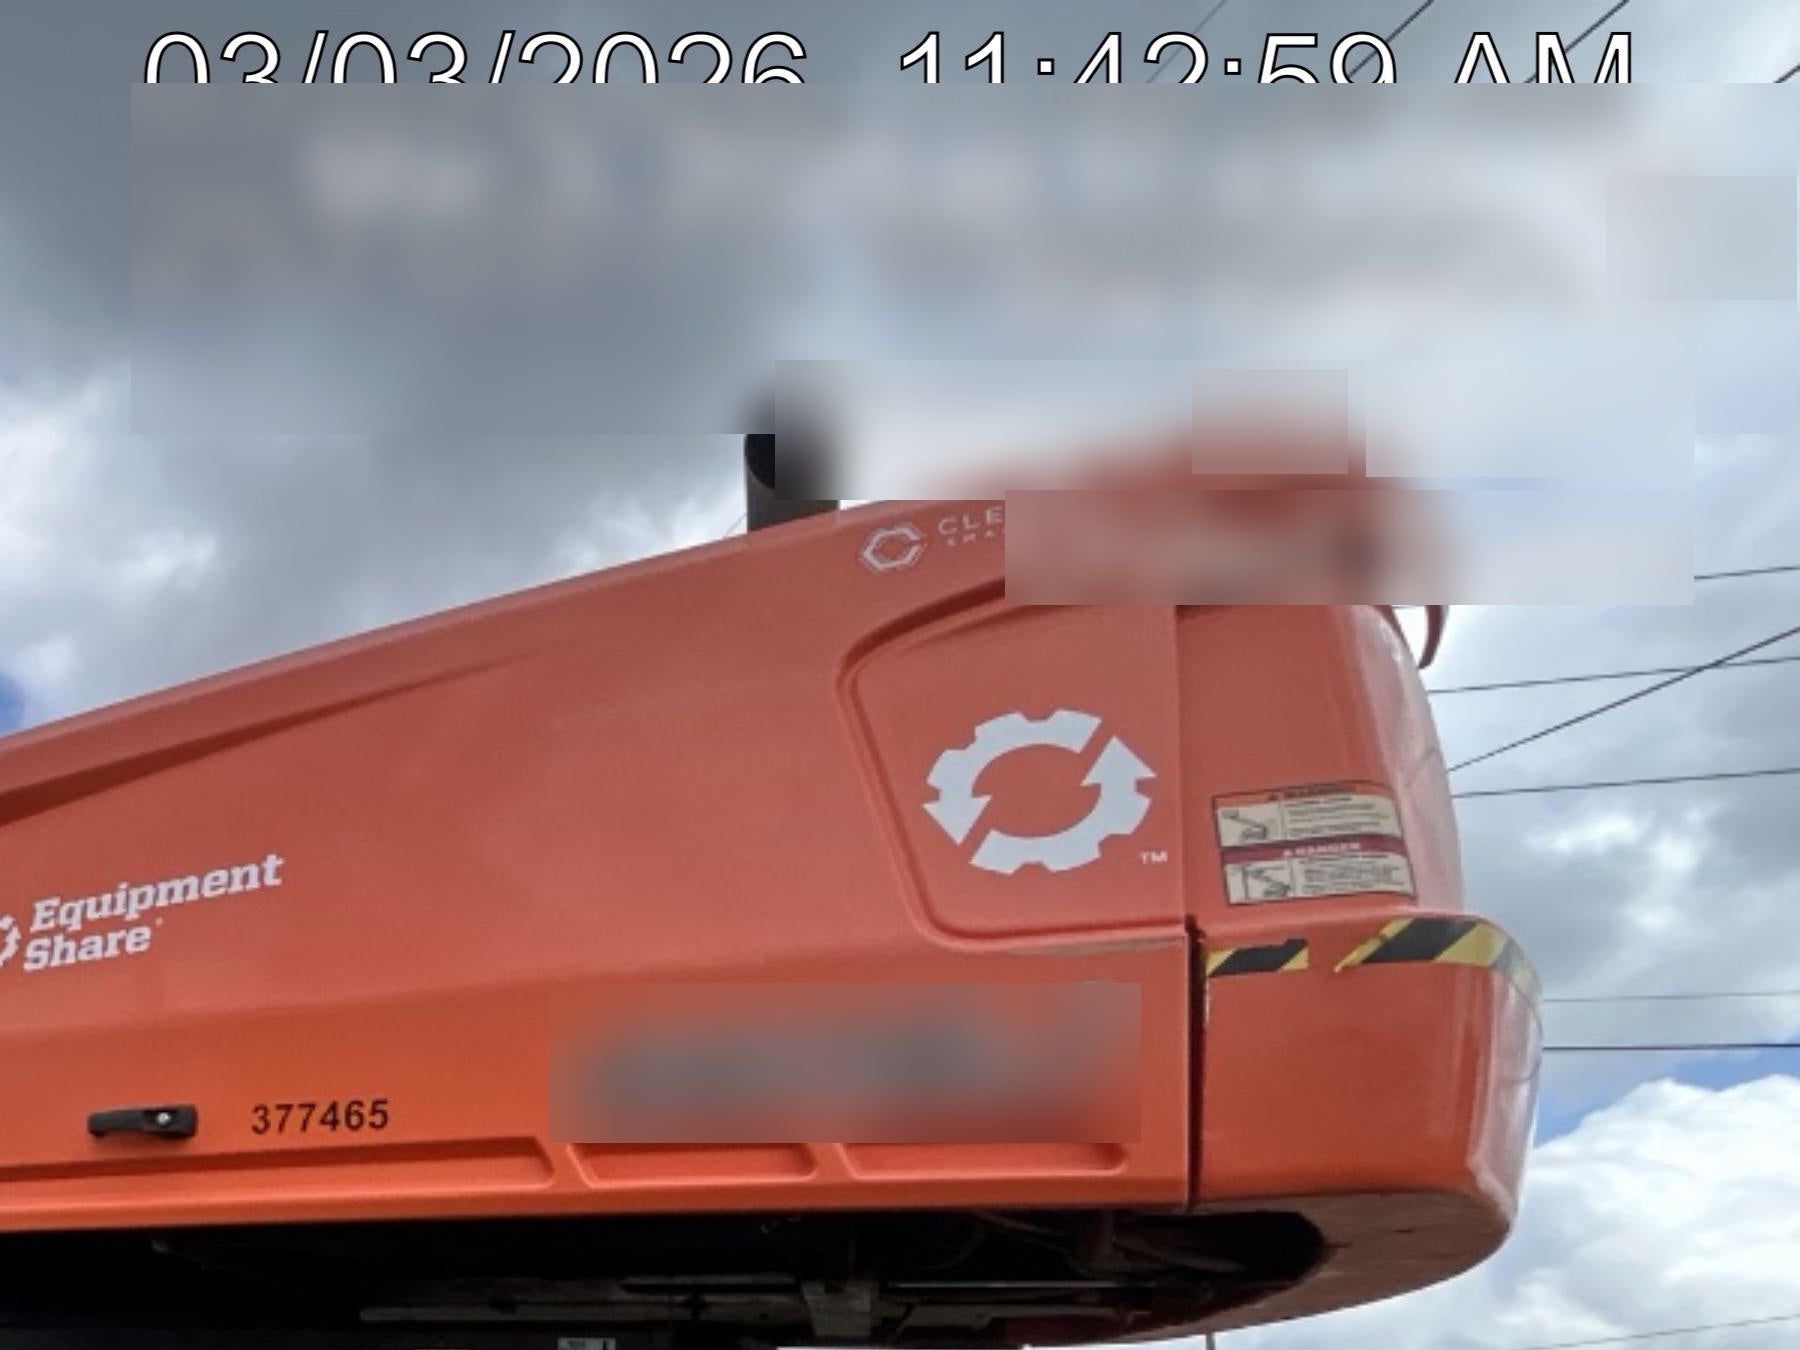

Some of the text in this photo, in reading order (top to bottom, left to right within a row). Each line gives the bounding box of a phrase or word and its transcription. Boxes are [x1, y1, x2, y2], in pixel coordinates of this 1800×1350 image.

[29, 853, 285, 935] Equipment
[23, 923, 152, 971] Share
[251, 1100, 389, 1135] 377465
